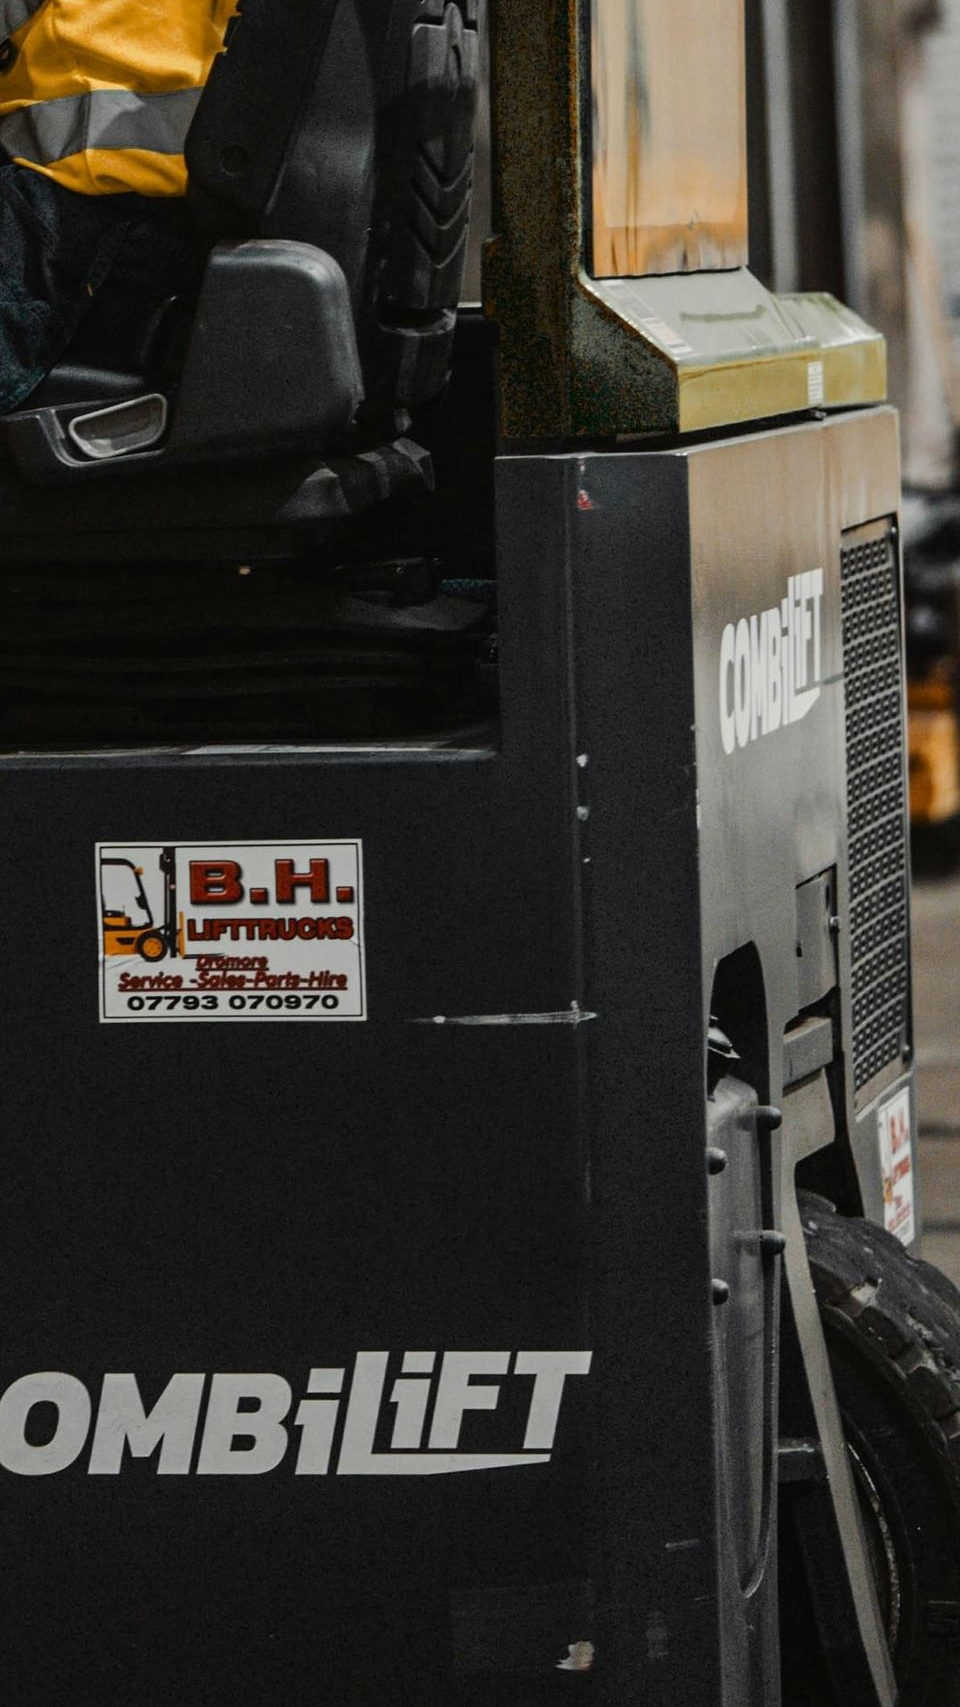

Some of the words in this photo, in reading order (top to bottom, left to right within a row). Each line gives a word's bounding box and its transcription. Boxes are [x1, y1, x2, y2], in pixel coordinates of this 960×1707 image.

[189, 858, 355, 905] B.H.
[187, 917, 355, 941] LIFTTRUCKS
[196, 955, 268, 968] Dromore
[118, 972, 183, 989] Service
[127, 995, 218, 1011] 07793
[228, 994, 339, 1010] 070970
